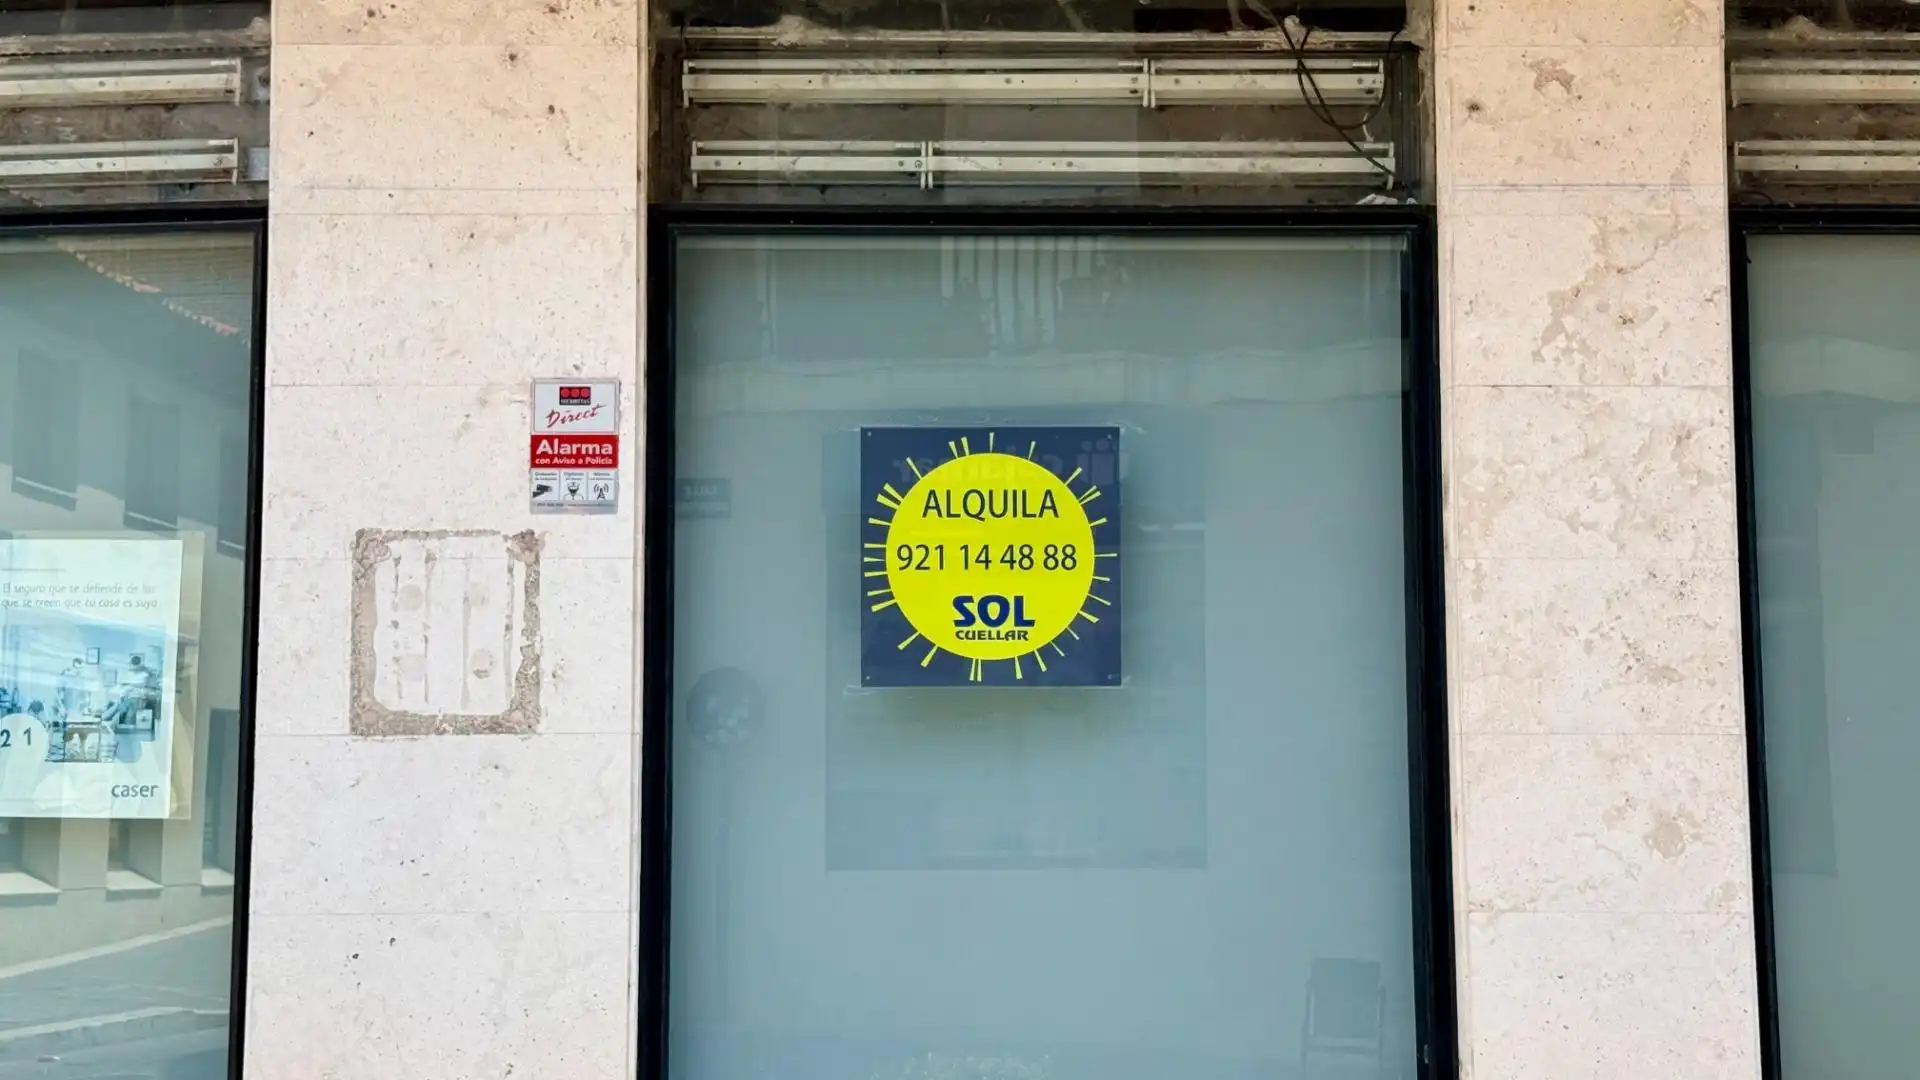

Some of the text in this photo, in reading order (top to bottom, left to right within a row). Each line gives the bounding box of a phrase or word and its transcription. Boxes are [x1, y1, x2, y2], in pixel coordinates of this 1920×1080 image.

[545, 404, 607, 428] Direct
[536, 438, 613, 455] Alarma
[552, 457, 576, 465] Aviso
[922, 489, 1059, 522] ALQUILA
[896, 544, 1078, 571] 921 14 48 88
[98, 599, 120, 608] casa
[135, 599, 158, 610] suya
[952, 594, 1036, 628] SOL
[955, 630, 1029, 642] CUELLAR
[111, 783, 159, 798] caser
